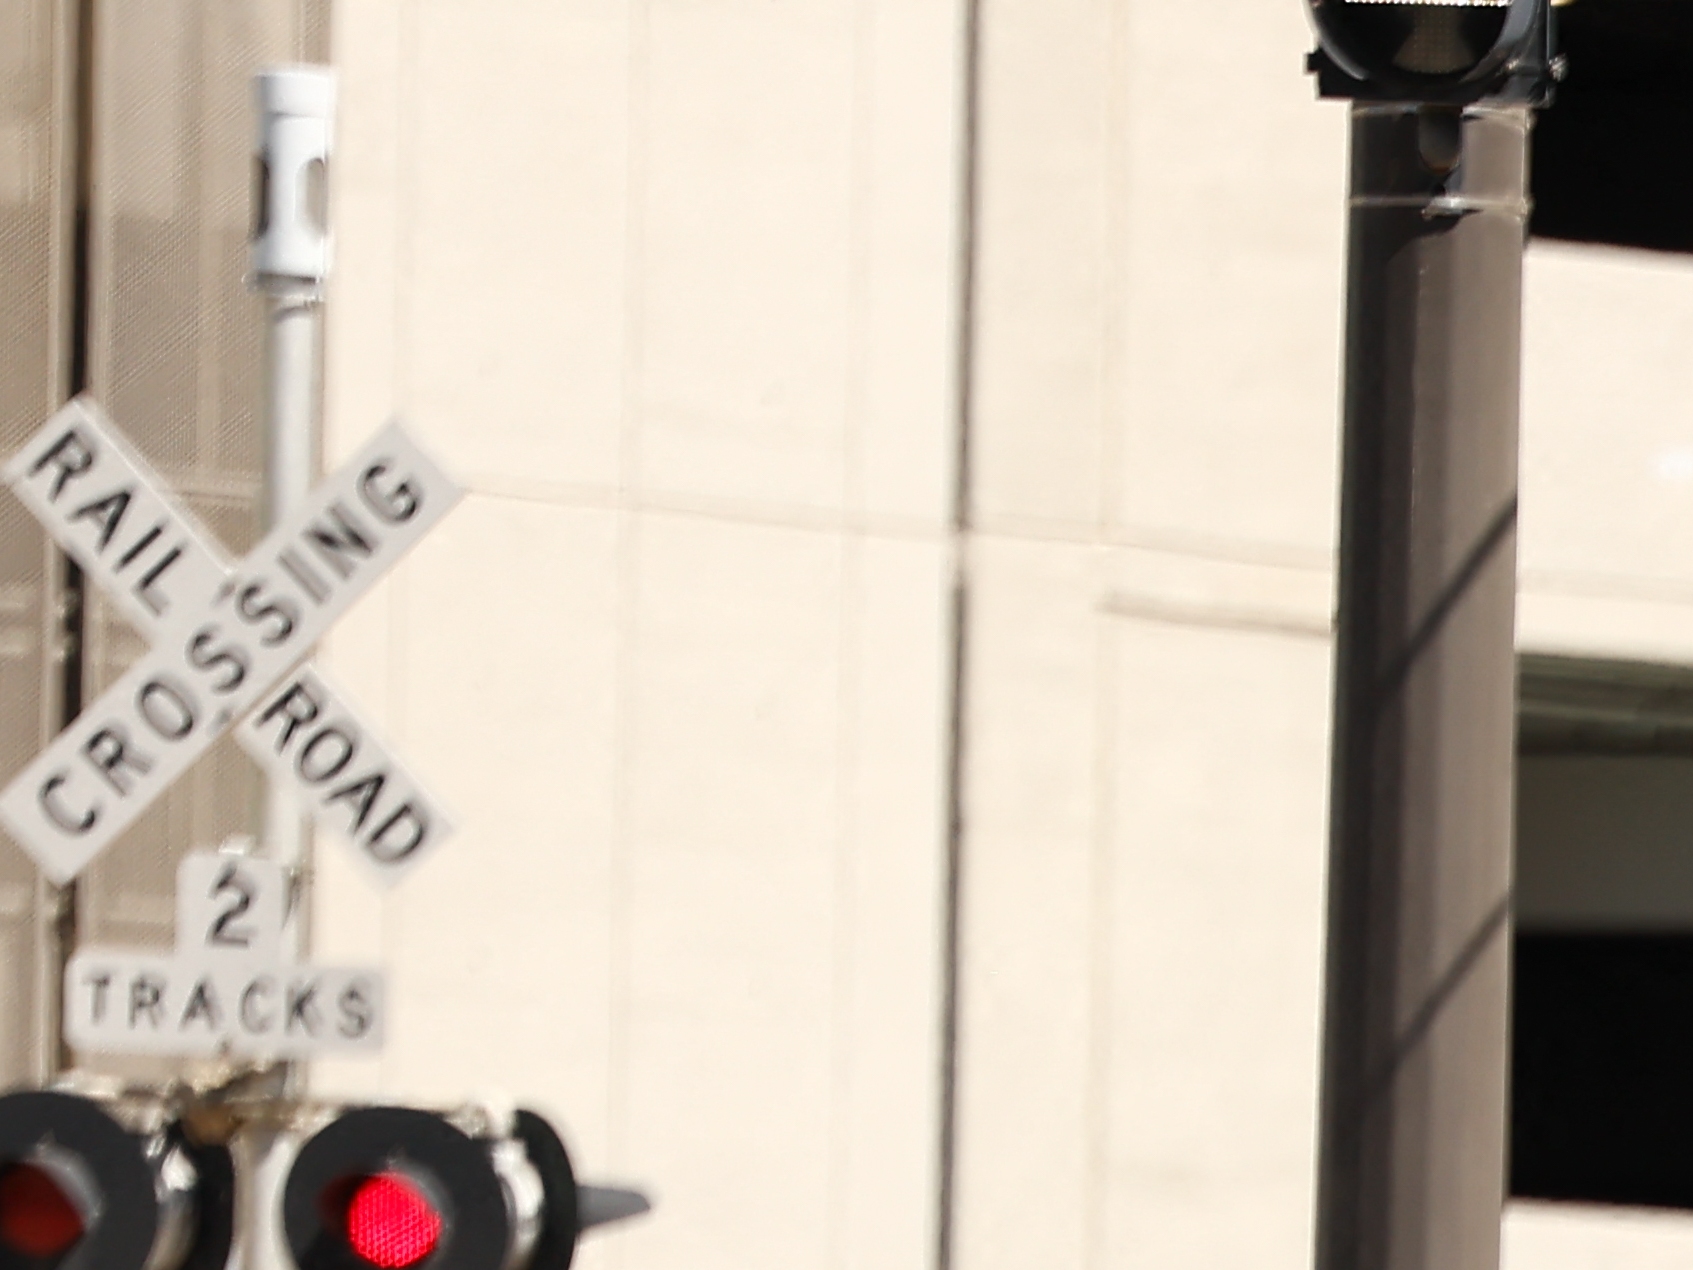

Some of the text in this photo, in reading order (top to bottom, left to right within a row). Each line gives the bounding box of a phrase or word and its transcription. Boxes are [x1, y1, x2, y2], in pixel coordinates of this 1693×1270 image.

[28, 429, 427, 866] RAIL ROAD
[37, 456, 422, 837] CROSSING
[82, 974, 374, 1040] TRACKS
[207, 859, 252, 946] 2
